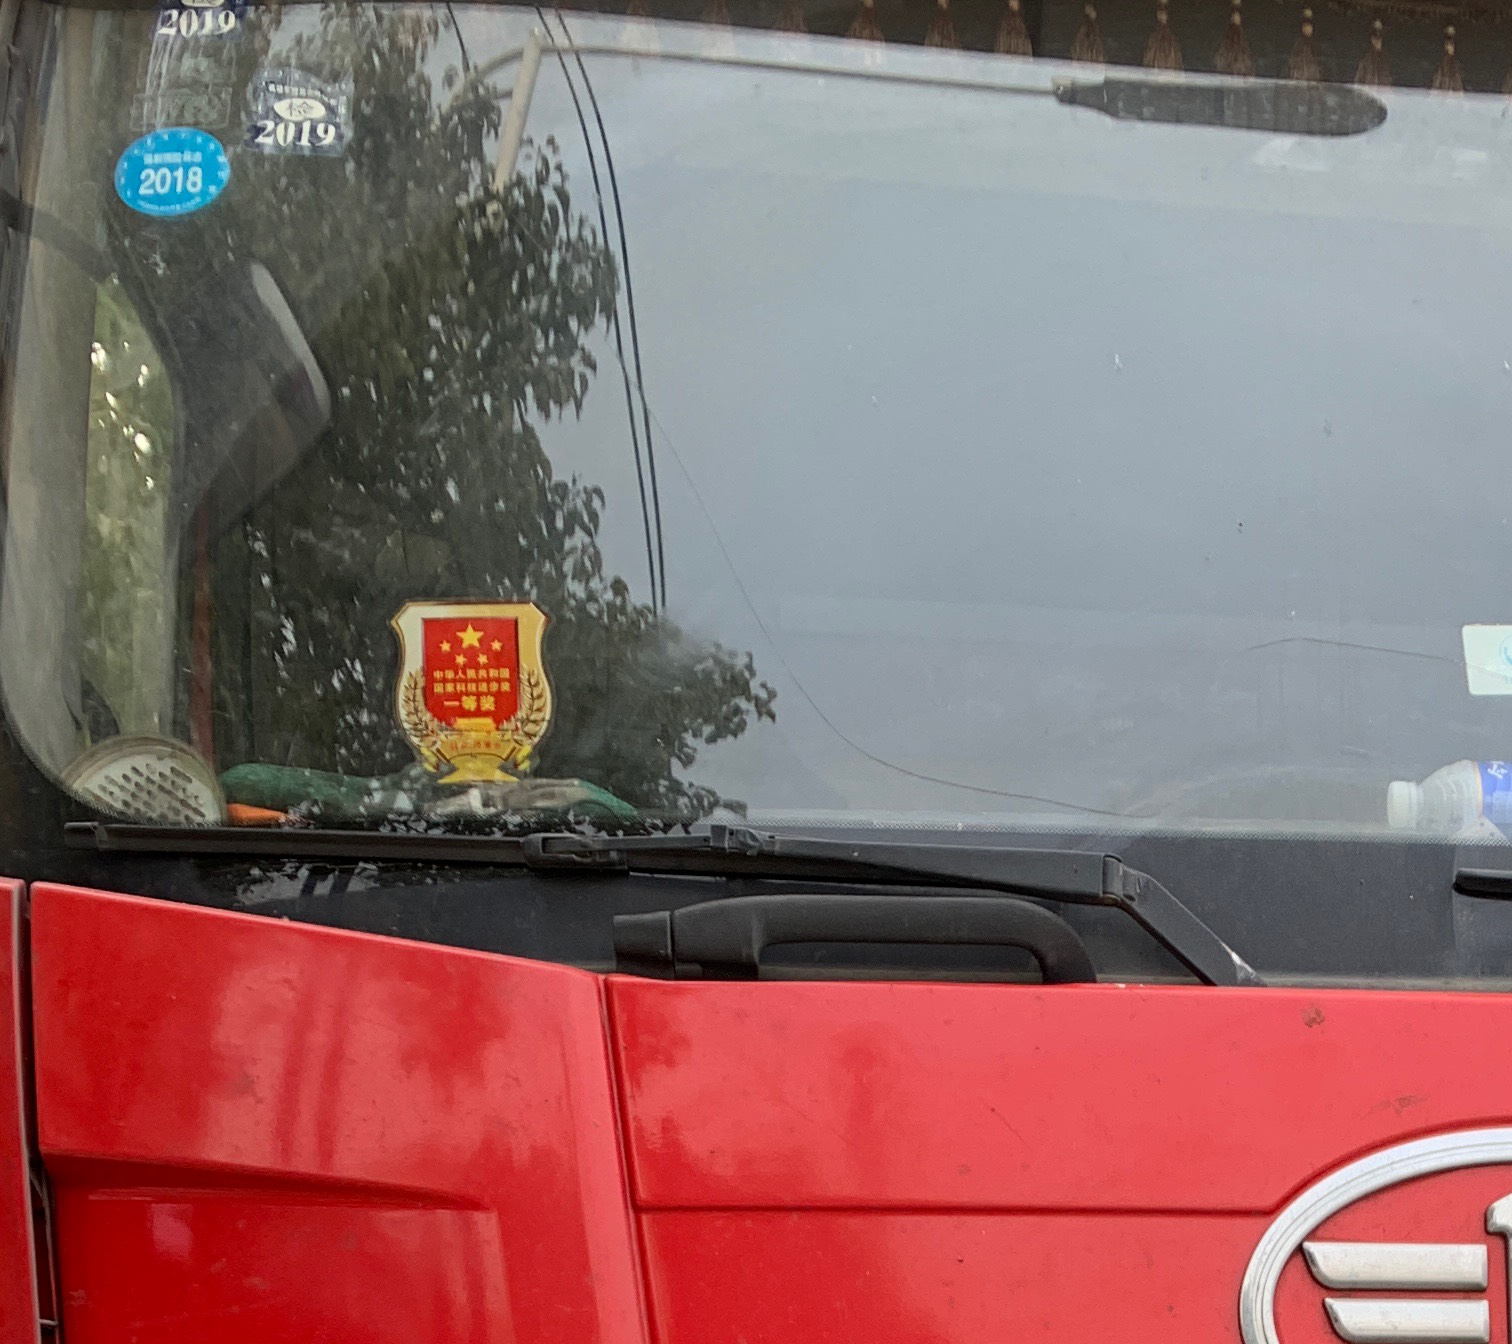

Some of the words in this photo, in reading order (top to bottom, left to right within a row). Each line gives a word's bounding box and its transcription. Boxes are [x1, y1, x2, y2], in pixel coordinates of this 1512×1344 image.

[157, 9, 236, 38] 2019
[254, 119, 336, 147] 2019
[138, 166, 203, 195] 2018
